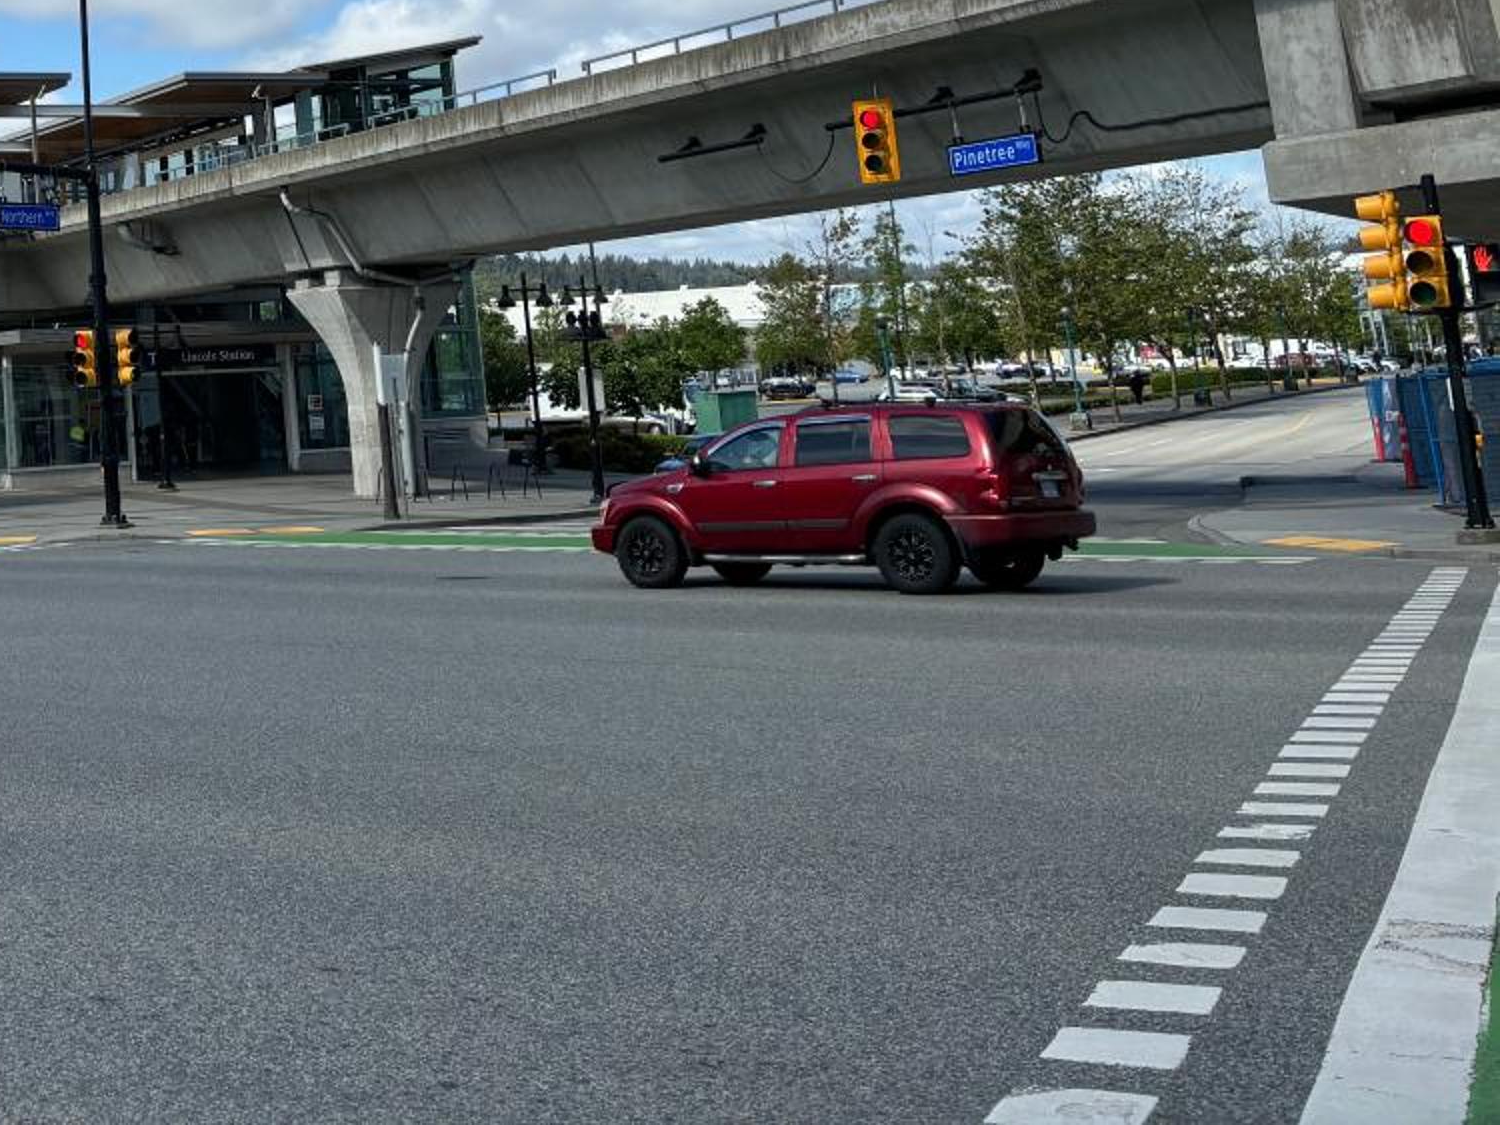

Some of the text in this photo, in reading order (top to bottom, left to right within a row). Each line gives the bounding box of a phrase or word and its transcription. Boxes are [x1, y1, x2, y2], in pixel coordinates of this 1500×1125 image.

[953, 146, 1015, 168] Pinetree
[2, 210, 45, 226] Northern
[219, 350, 255, 363] Station
